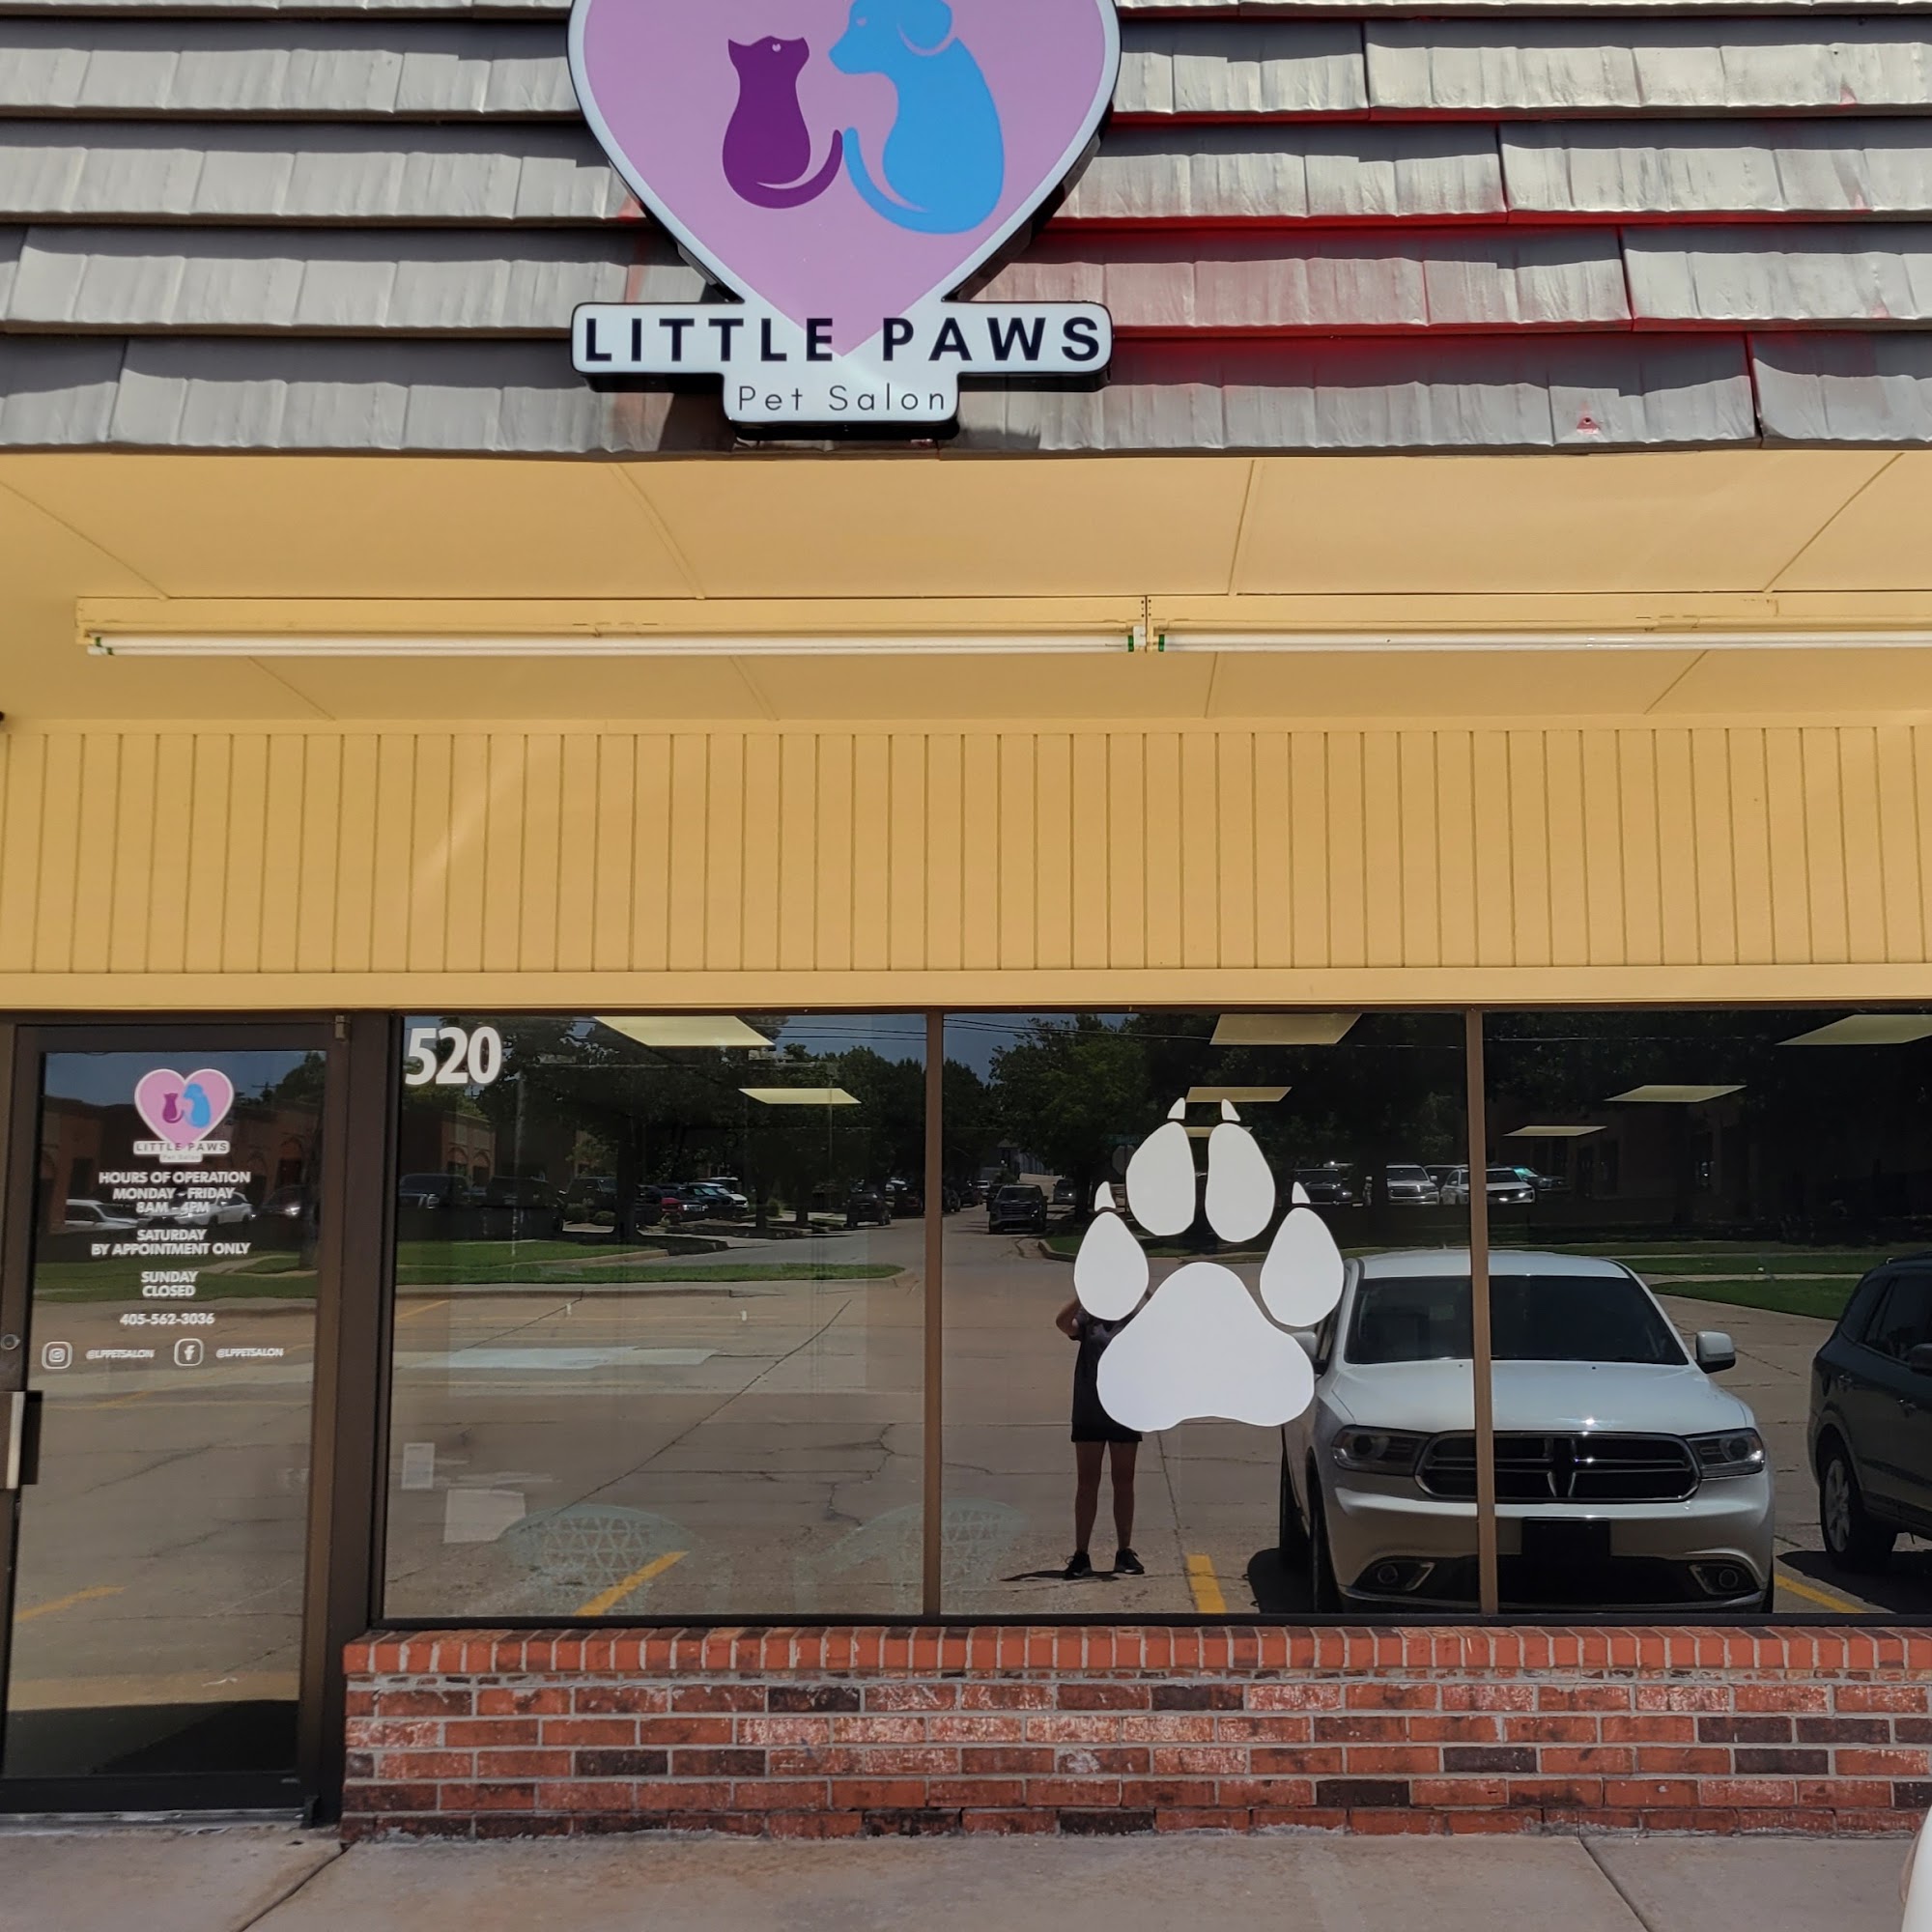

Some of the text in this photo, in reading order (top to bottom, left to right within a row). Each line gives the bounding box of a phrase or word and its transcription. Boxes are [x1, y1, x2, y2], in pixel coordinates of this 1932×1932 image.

[585, 317, 1100, 362] LITTLE PAWS
[738, 384, 945, 412] Pet Salon
[405, 1026, 502, 1086] 520
[136, 1142, 228, 1151] LITTLE PAWS
[99, 1171, 251, 1184] HOURS OF OPERATION
[112, 1187, 177, 1200] MONDAY
[187, 1186, 236, 1200] FRIDAY
[135, 1201, 169, 1214] 8AM
[180, 1201, 211, 1214] 4PM
[136, 1229, 208, 1241] SATURDAY
[91, 1241, 251, 1256] BY APPOINTMENT ONLY
[140, 1270, 199, 1283] SUNDAY
[142, 1284, 197, 1297] CLOSED
[119, 1313, 215, 1326] 405-562-3036
